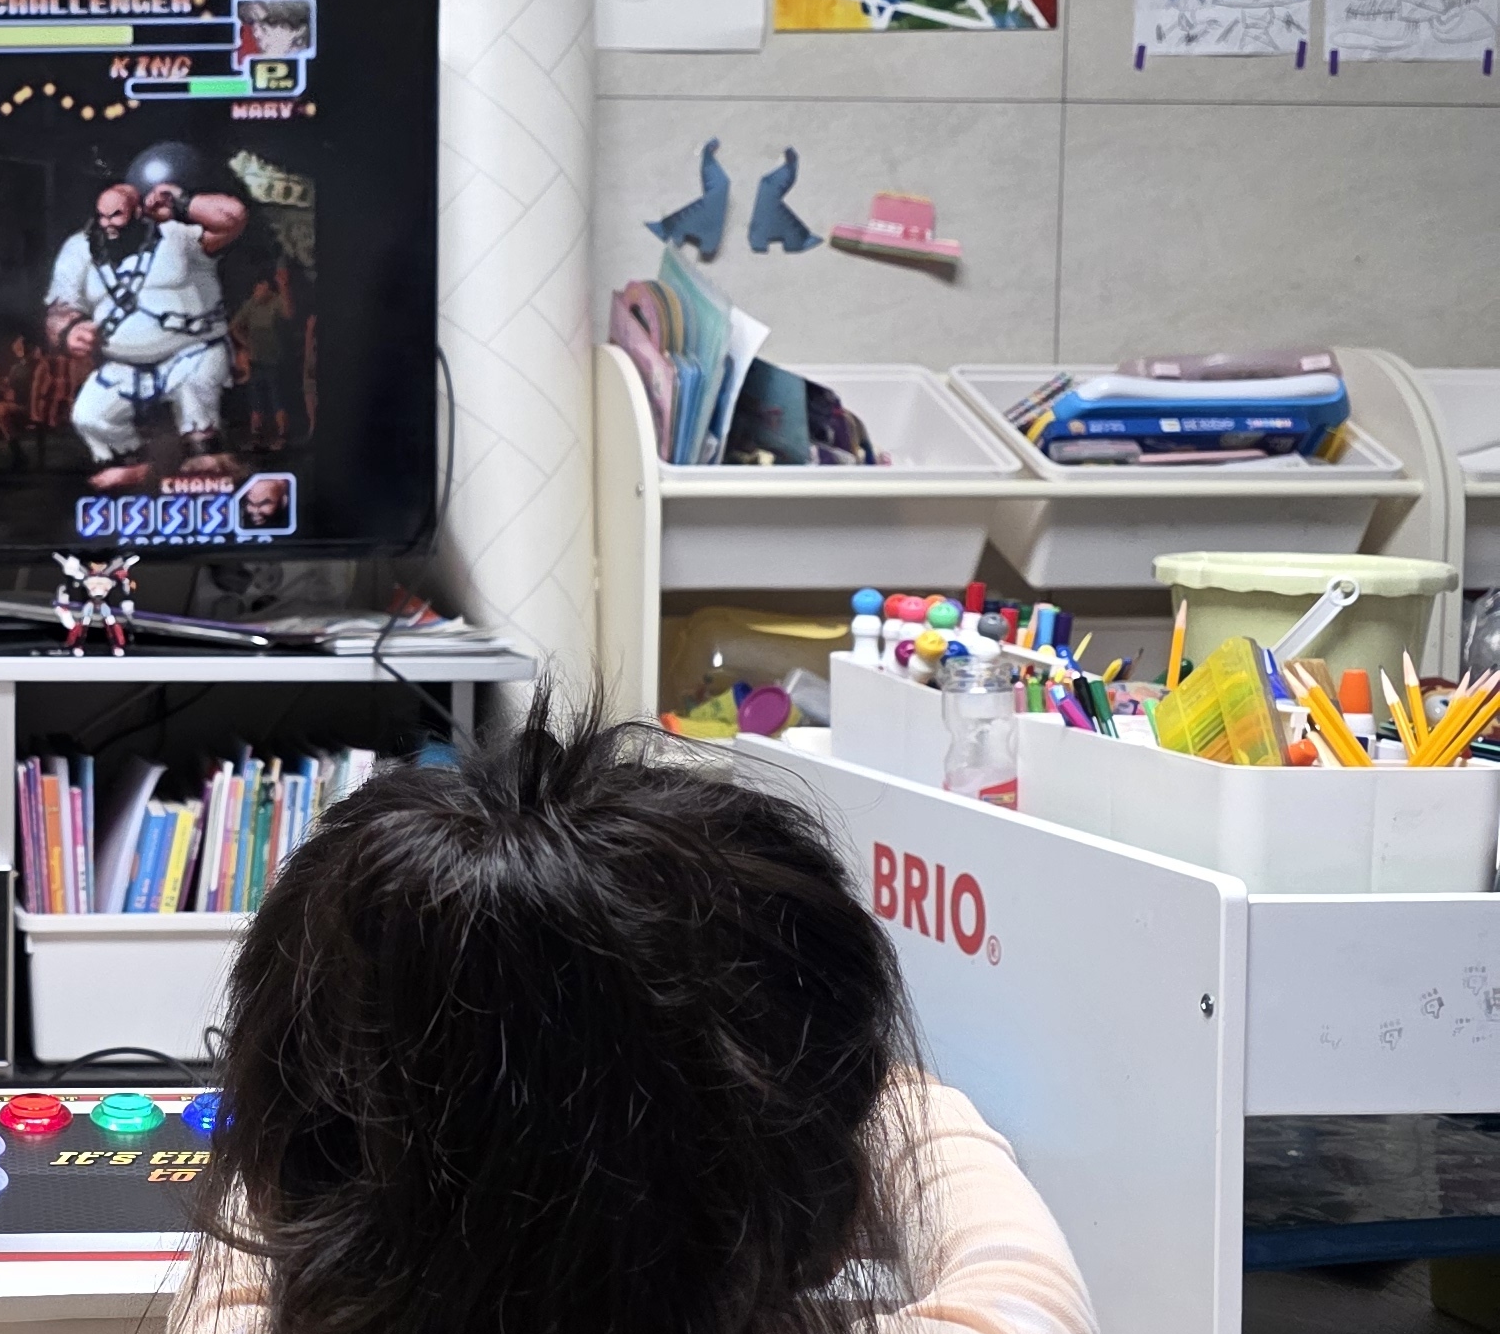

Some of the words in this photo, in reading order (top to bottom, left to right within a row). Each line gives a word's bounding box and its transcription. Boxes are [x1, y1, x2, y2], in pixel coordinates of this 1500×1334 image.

[109, 54, 194, 78] KING
[231, 101, 294, 120] MARY
[160, 476, 235, 495] CHANG
[49, 1150, 143, 1166] It's
[147, 1168, 203, 1182] to
